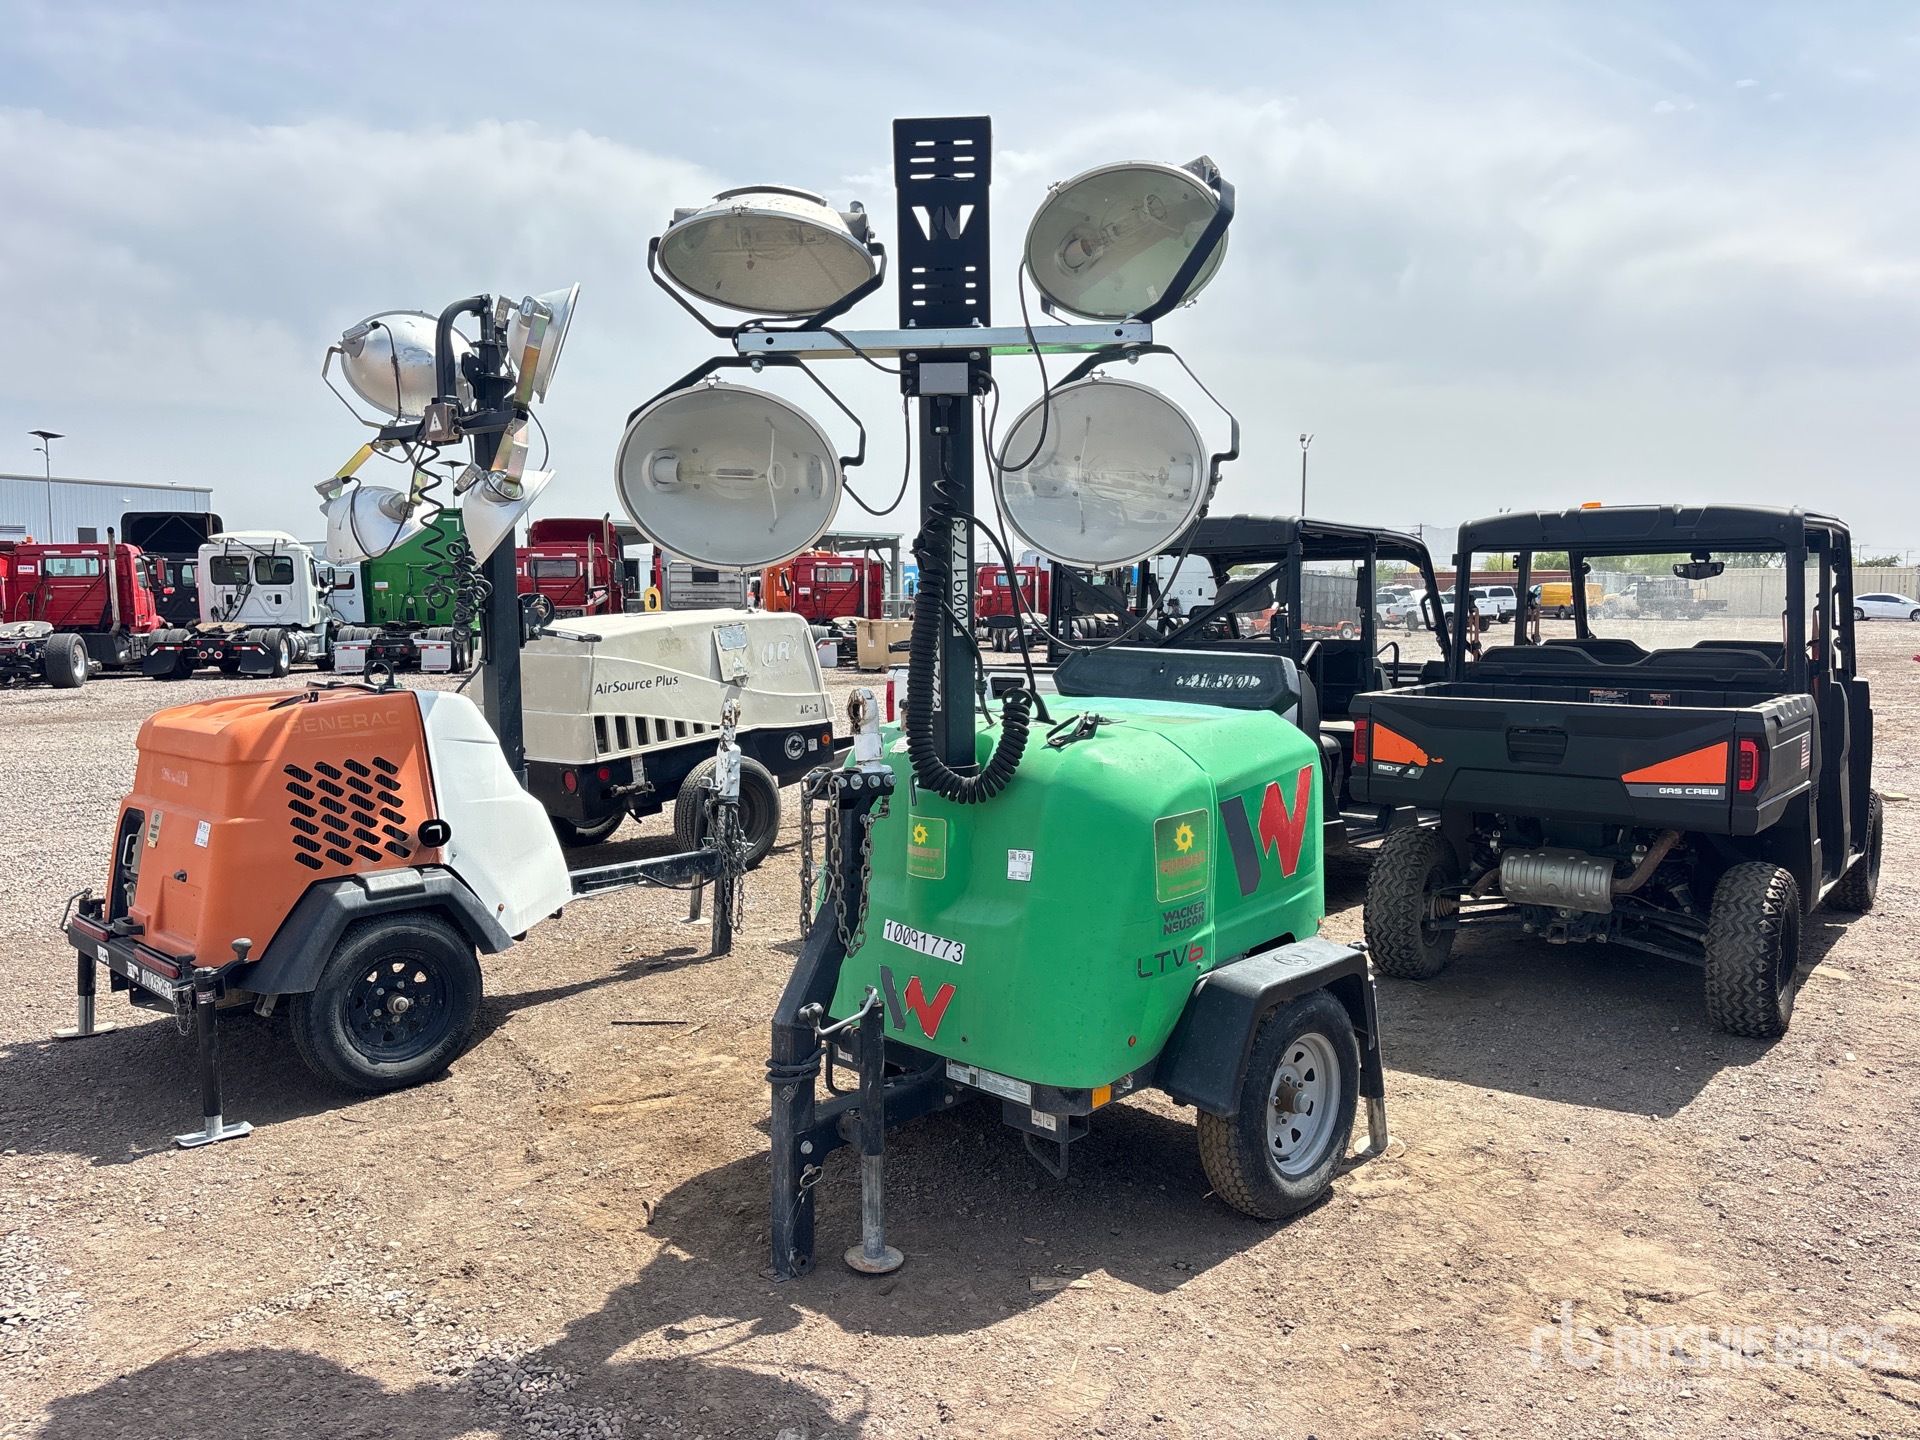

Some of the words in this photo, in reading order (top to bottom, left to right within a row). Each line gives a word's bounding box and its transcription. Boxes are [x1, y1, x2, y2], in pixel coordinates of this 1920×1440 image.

[594, 679, 652, 696] AirSource
[656, 674, 679, 687] Plus
[800, 703, 819, 714] AC-3
[284, 710, 401, 734] GENERAC
[1658, 787, 1682, 795] GAS
[1685, 788, 1719, 796] CREW
[1162, 901, 1205, 923] WACKER
[1163, 912, 1205, 935] NEUSON
[886, 921, 964, 962] 10091773
[1138, 942, 1204, 979] LTV6
